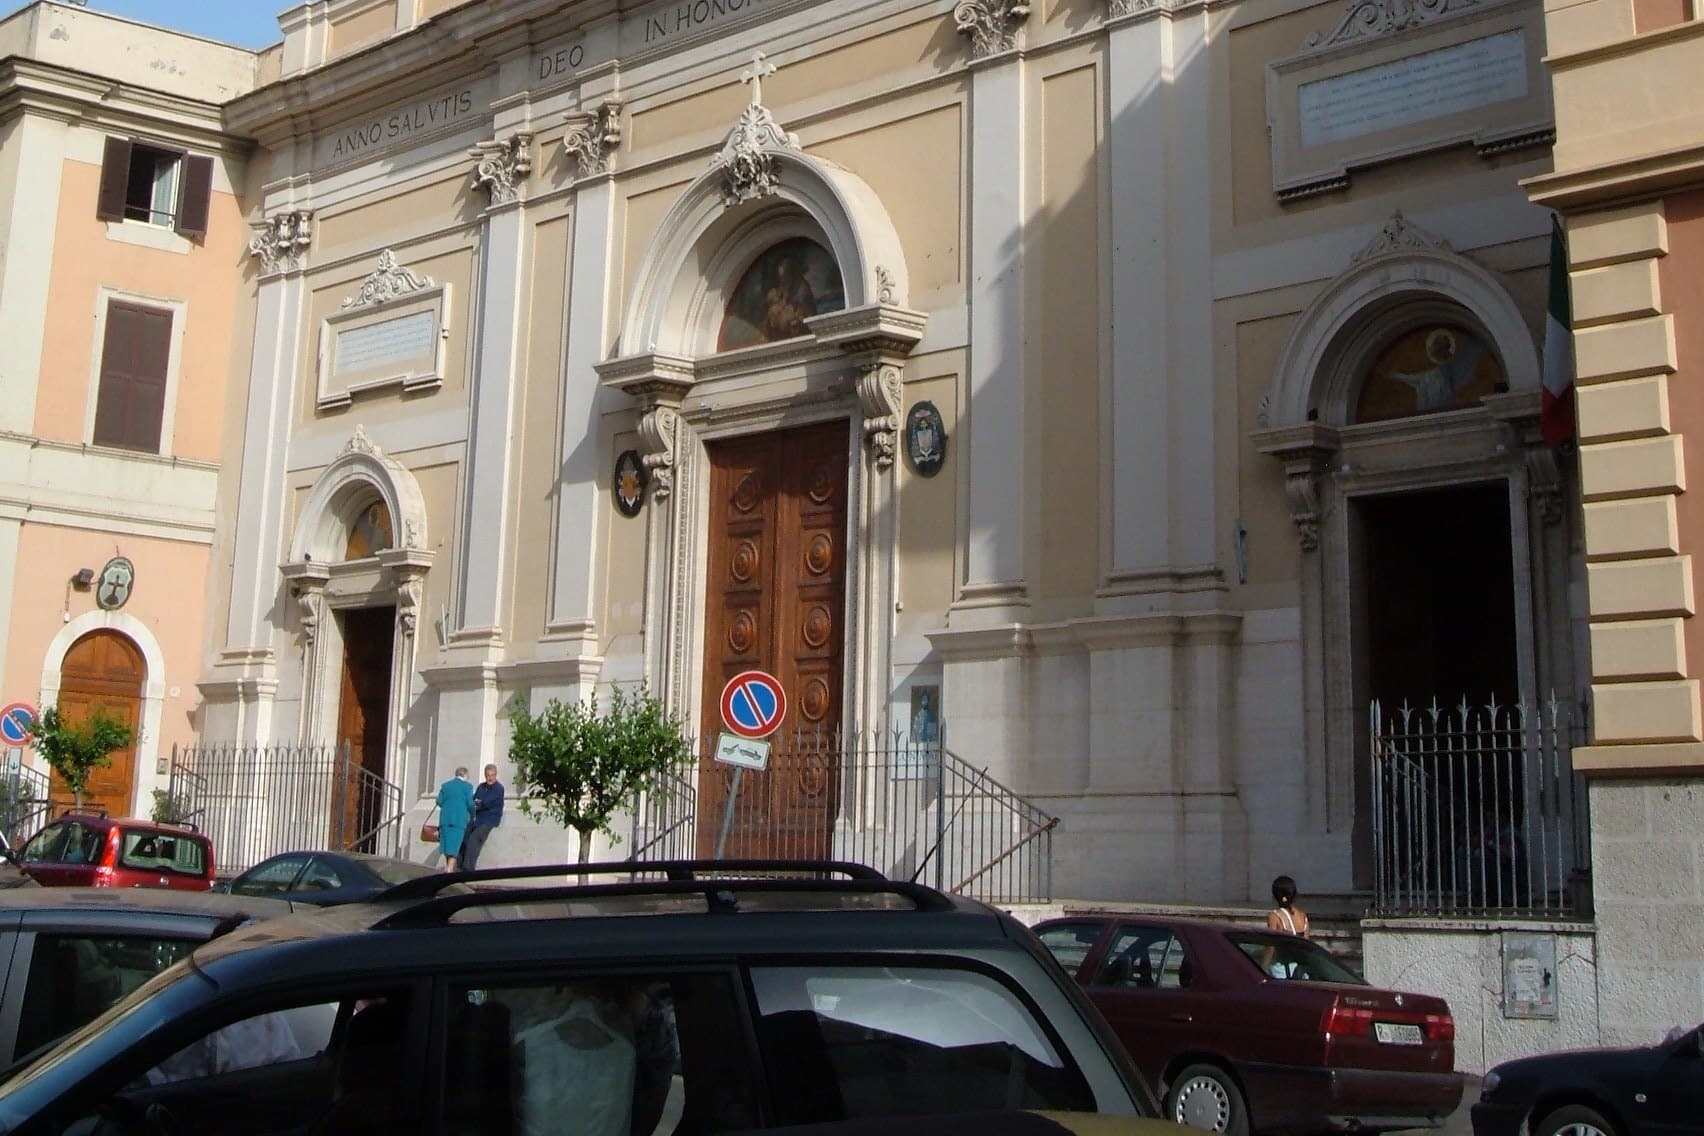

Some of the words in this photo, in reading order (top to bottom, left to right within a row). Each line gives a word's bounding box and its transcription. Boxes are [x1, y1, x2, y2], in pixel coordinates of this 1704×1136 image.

[539, 44, 584, 80] DEO
[333, 123, 382, 158] ANNO
[387, 90, 473, 137] SALVTIS
